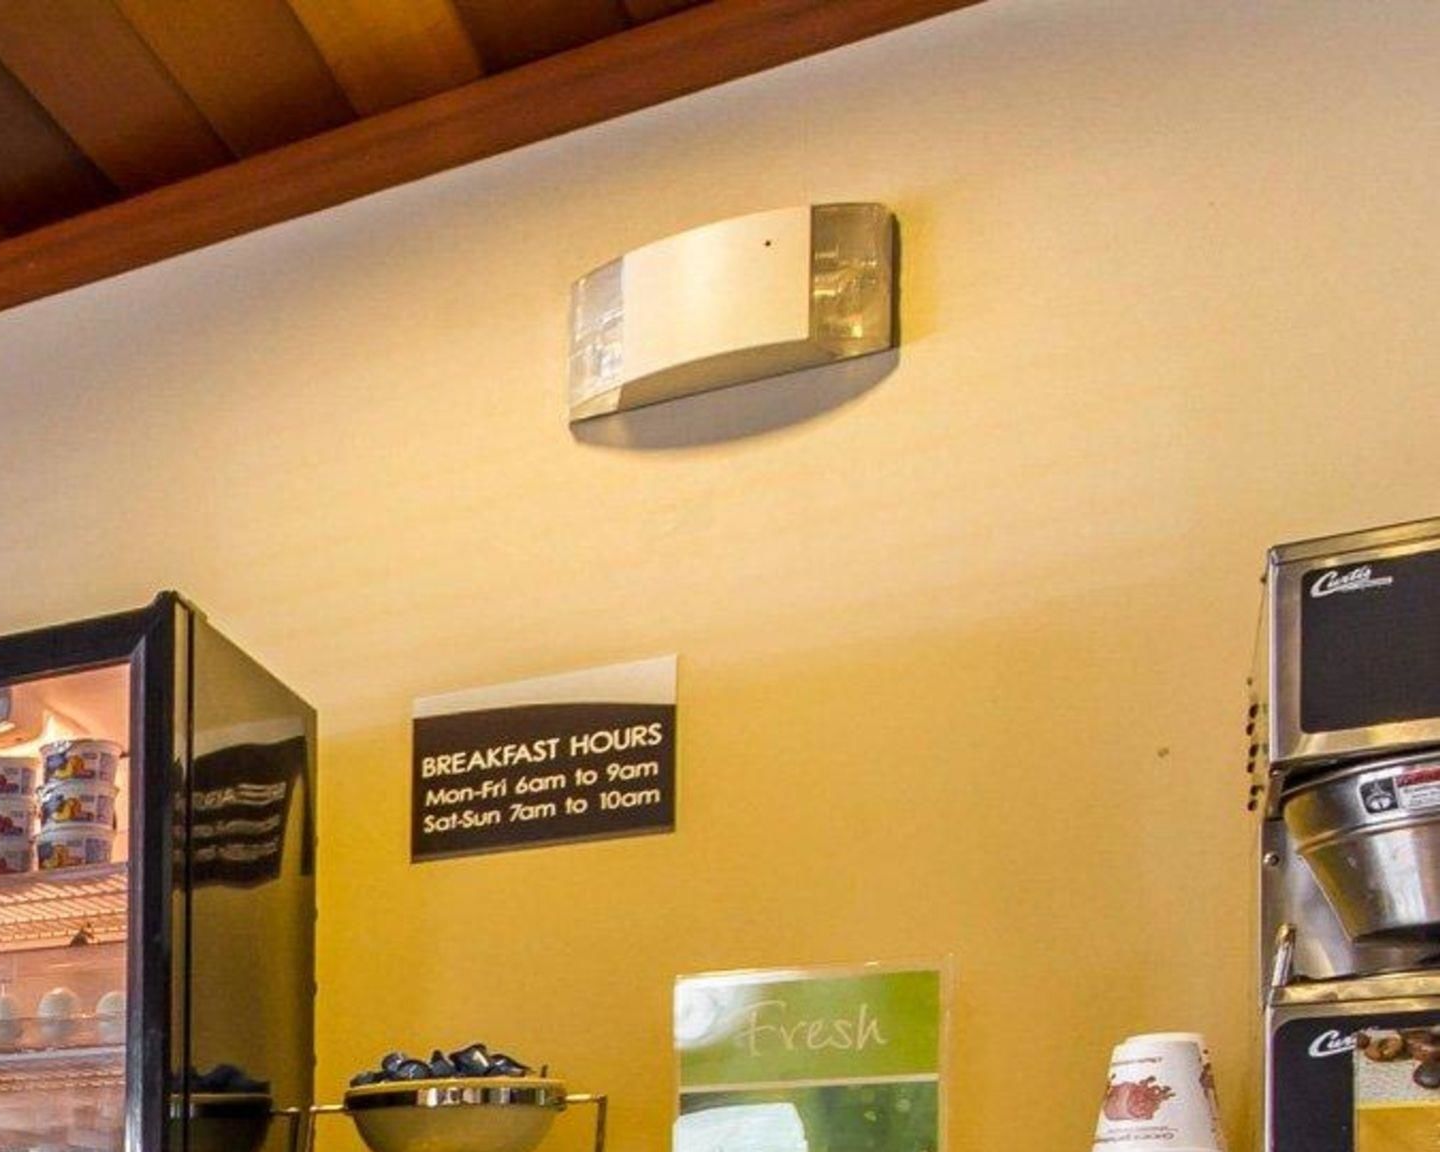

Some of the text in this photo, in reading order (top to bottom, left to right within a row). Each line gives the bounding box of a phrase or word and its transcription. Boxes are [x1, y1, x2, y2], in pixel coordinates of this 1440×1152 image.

[1310, 565, 1393, 598] Curtis
[421, 722, 664, 778] BREAKFAST HOURS
[425, 760, 659, 807] Mon-Fri 6am to 9am
[424, 788, 662, 833] Sat-Sun 7am to 10am
[735, 999, 888, 1057] Fresh
